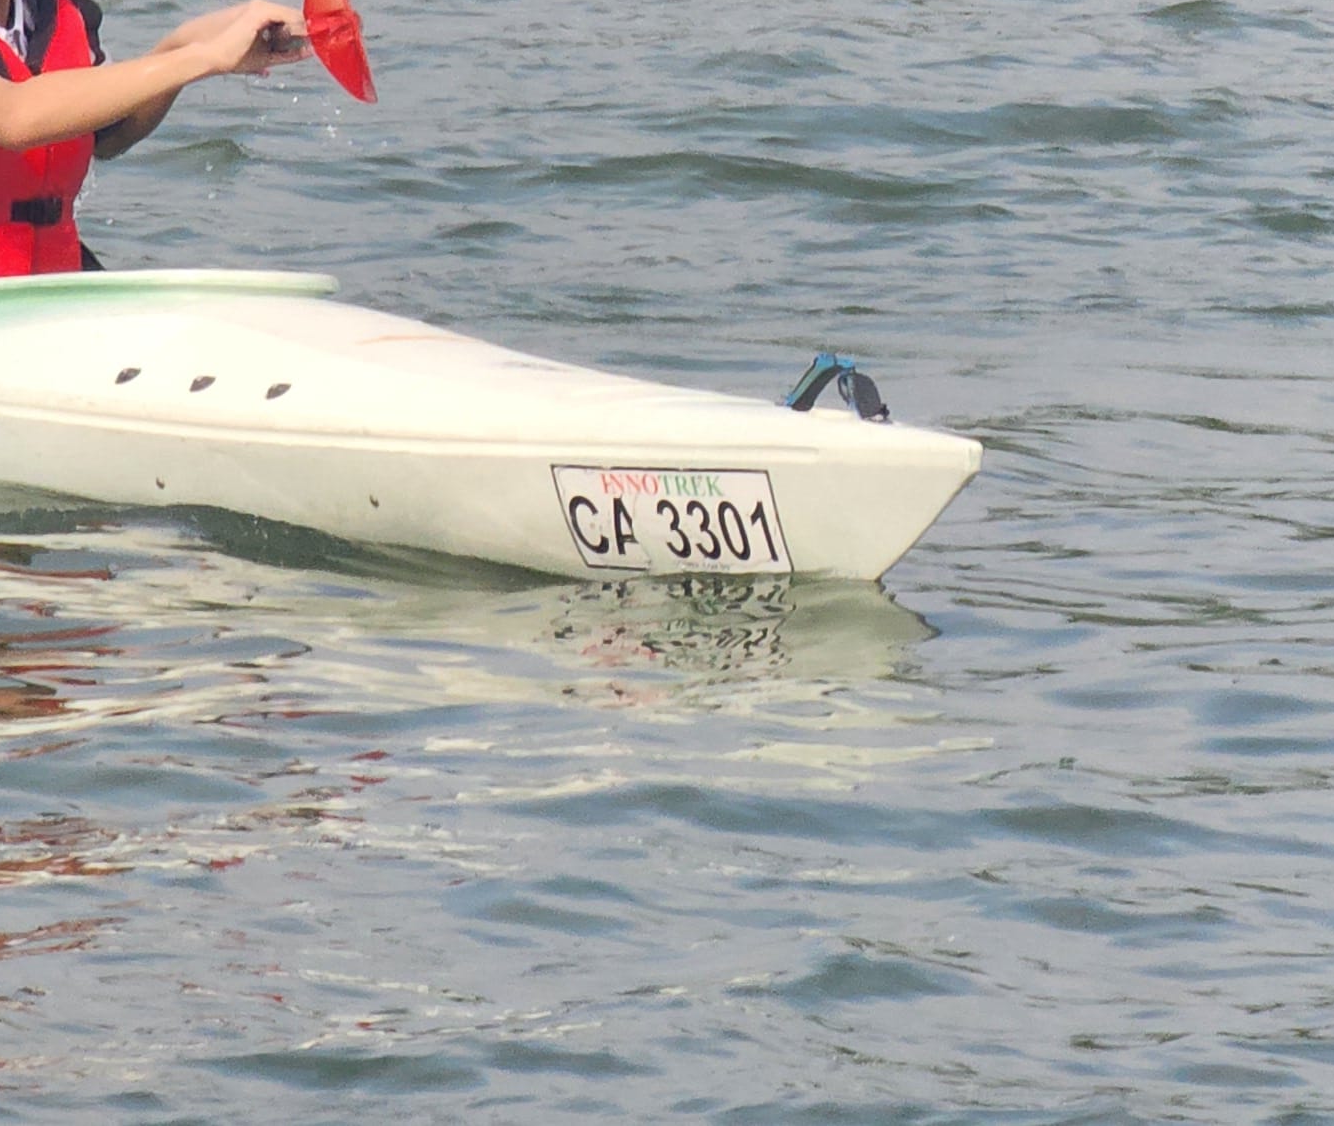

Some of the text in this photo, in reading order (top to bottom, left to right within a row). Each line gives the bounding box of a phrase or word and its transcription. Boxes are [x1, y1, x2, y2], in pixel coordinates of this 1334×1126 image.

[601, 473, 724, 496] INNOTREK
[569, 496, 779, 562] CA 3301
